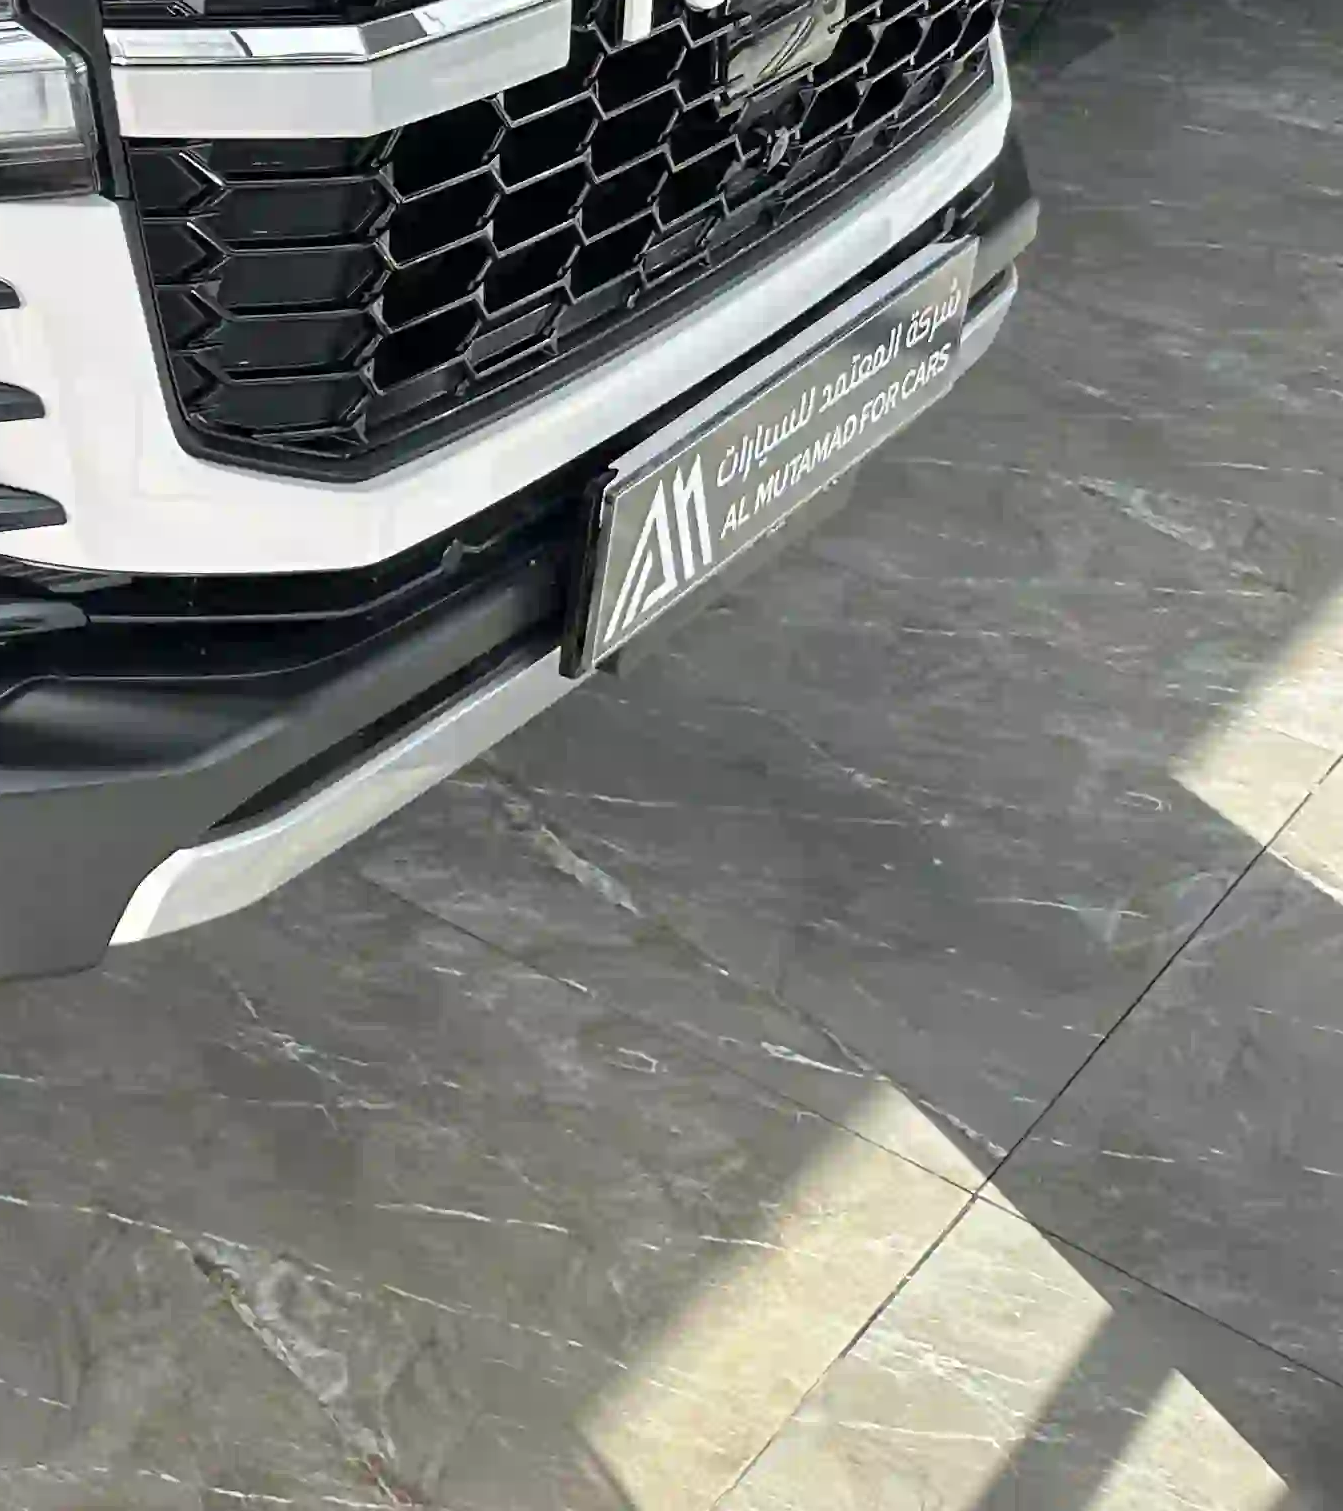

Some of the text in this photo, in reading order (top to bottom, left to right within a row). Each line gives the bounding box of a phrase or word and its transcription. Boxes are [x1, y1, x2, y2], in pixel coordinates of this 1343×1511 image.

[716, 278, 962, 488] شركة المعتمد للسيارات
[720, 343, 952, 539] AL MUTAMAD FOR CARS
